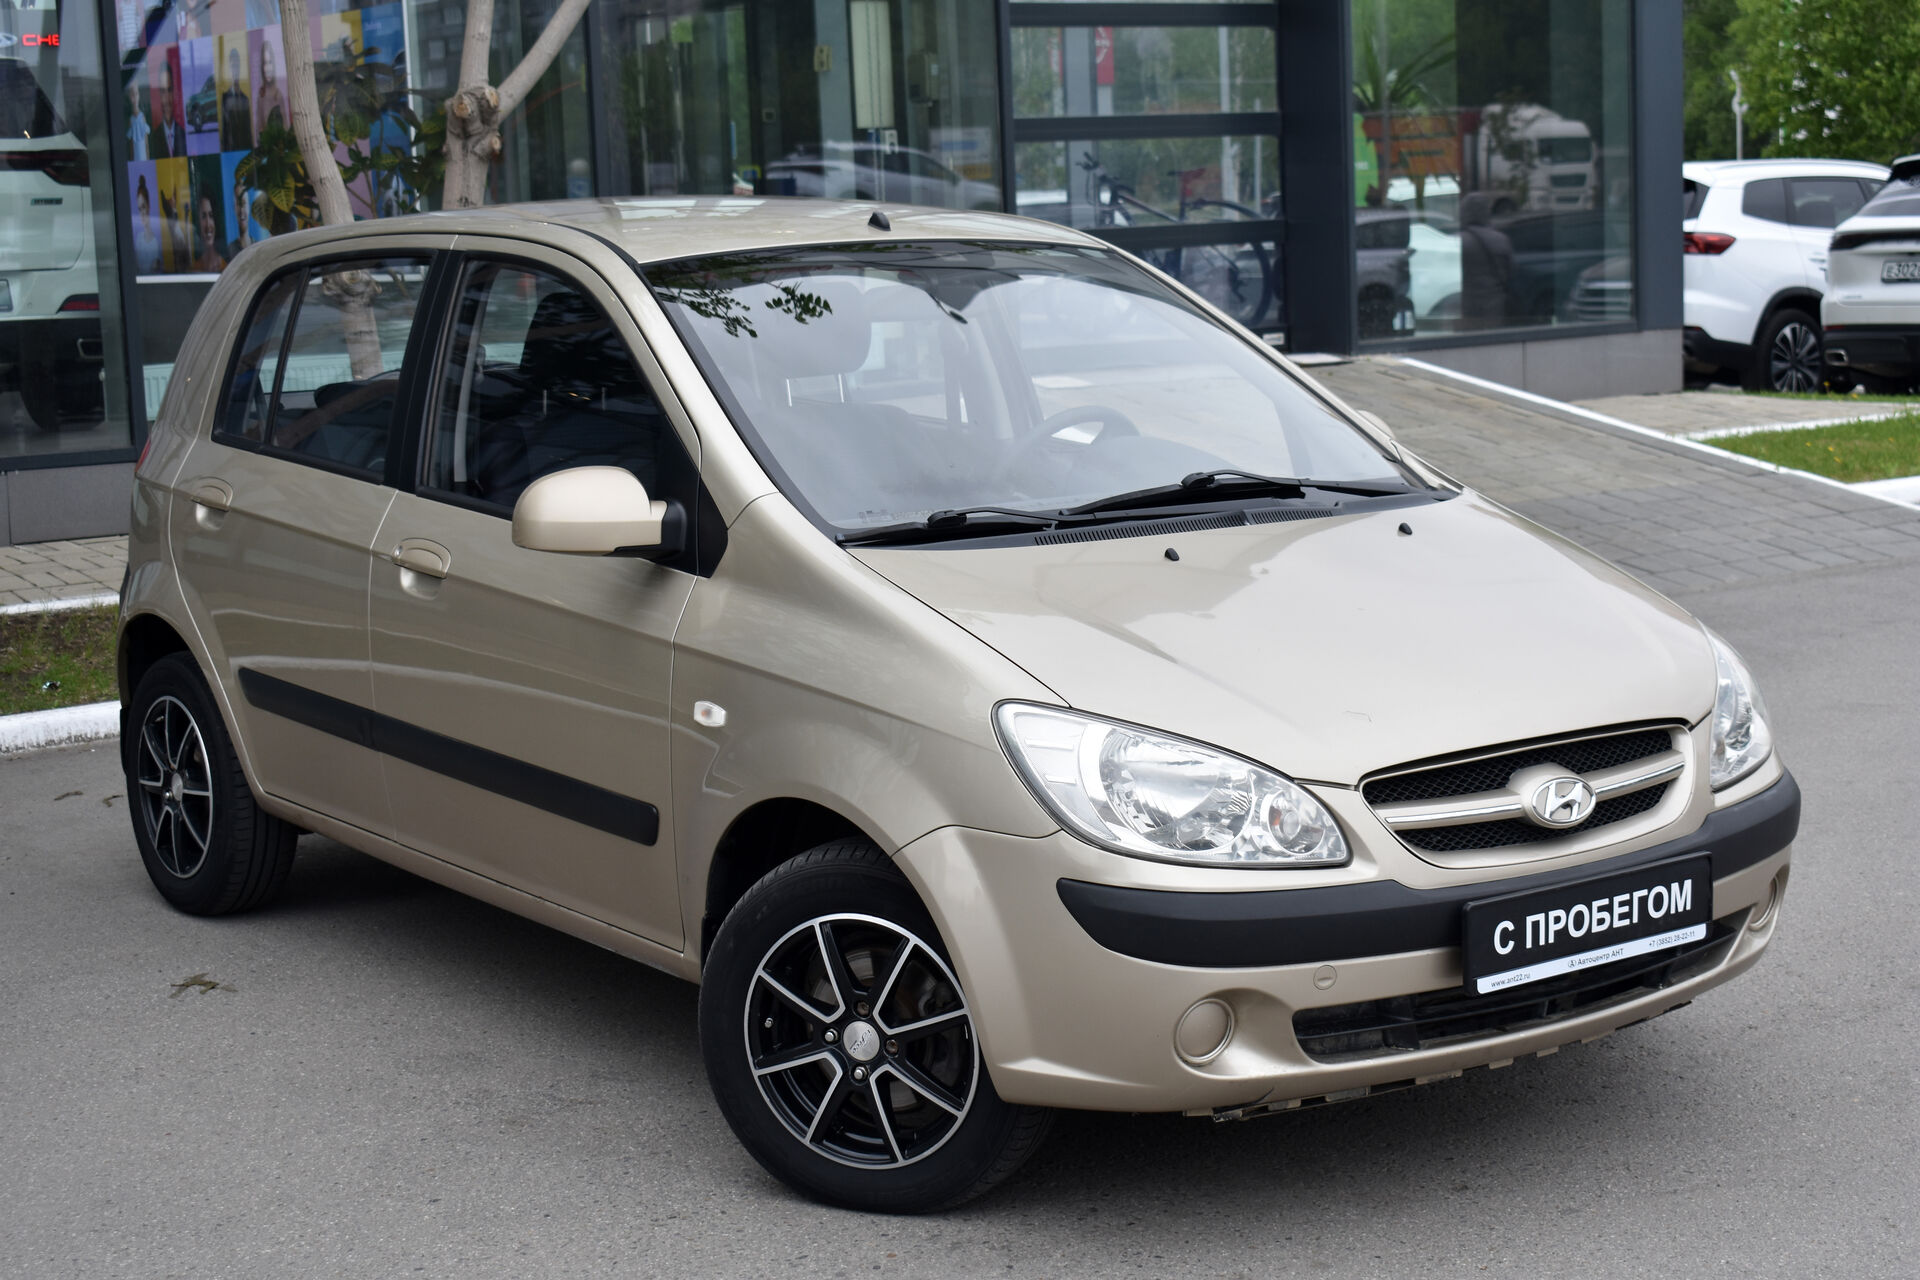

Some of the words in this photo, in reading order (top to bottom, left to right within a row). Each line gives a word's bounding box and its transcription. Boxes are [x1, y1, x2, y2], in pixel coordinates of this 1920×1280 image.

[1493, 920, 1515, 955] С
[1526, 879, 1692, 949] ПРОБЕГОМ
[1577, 953, 1610, 966] Автоцентр
[1611, 948, 1624, 958] АНТ
